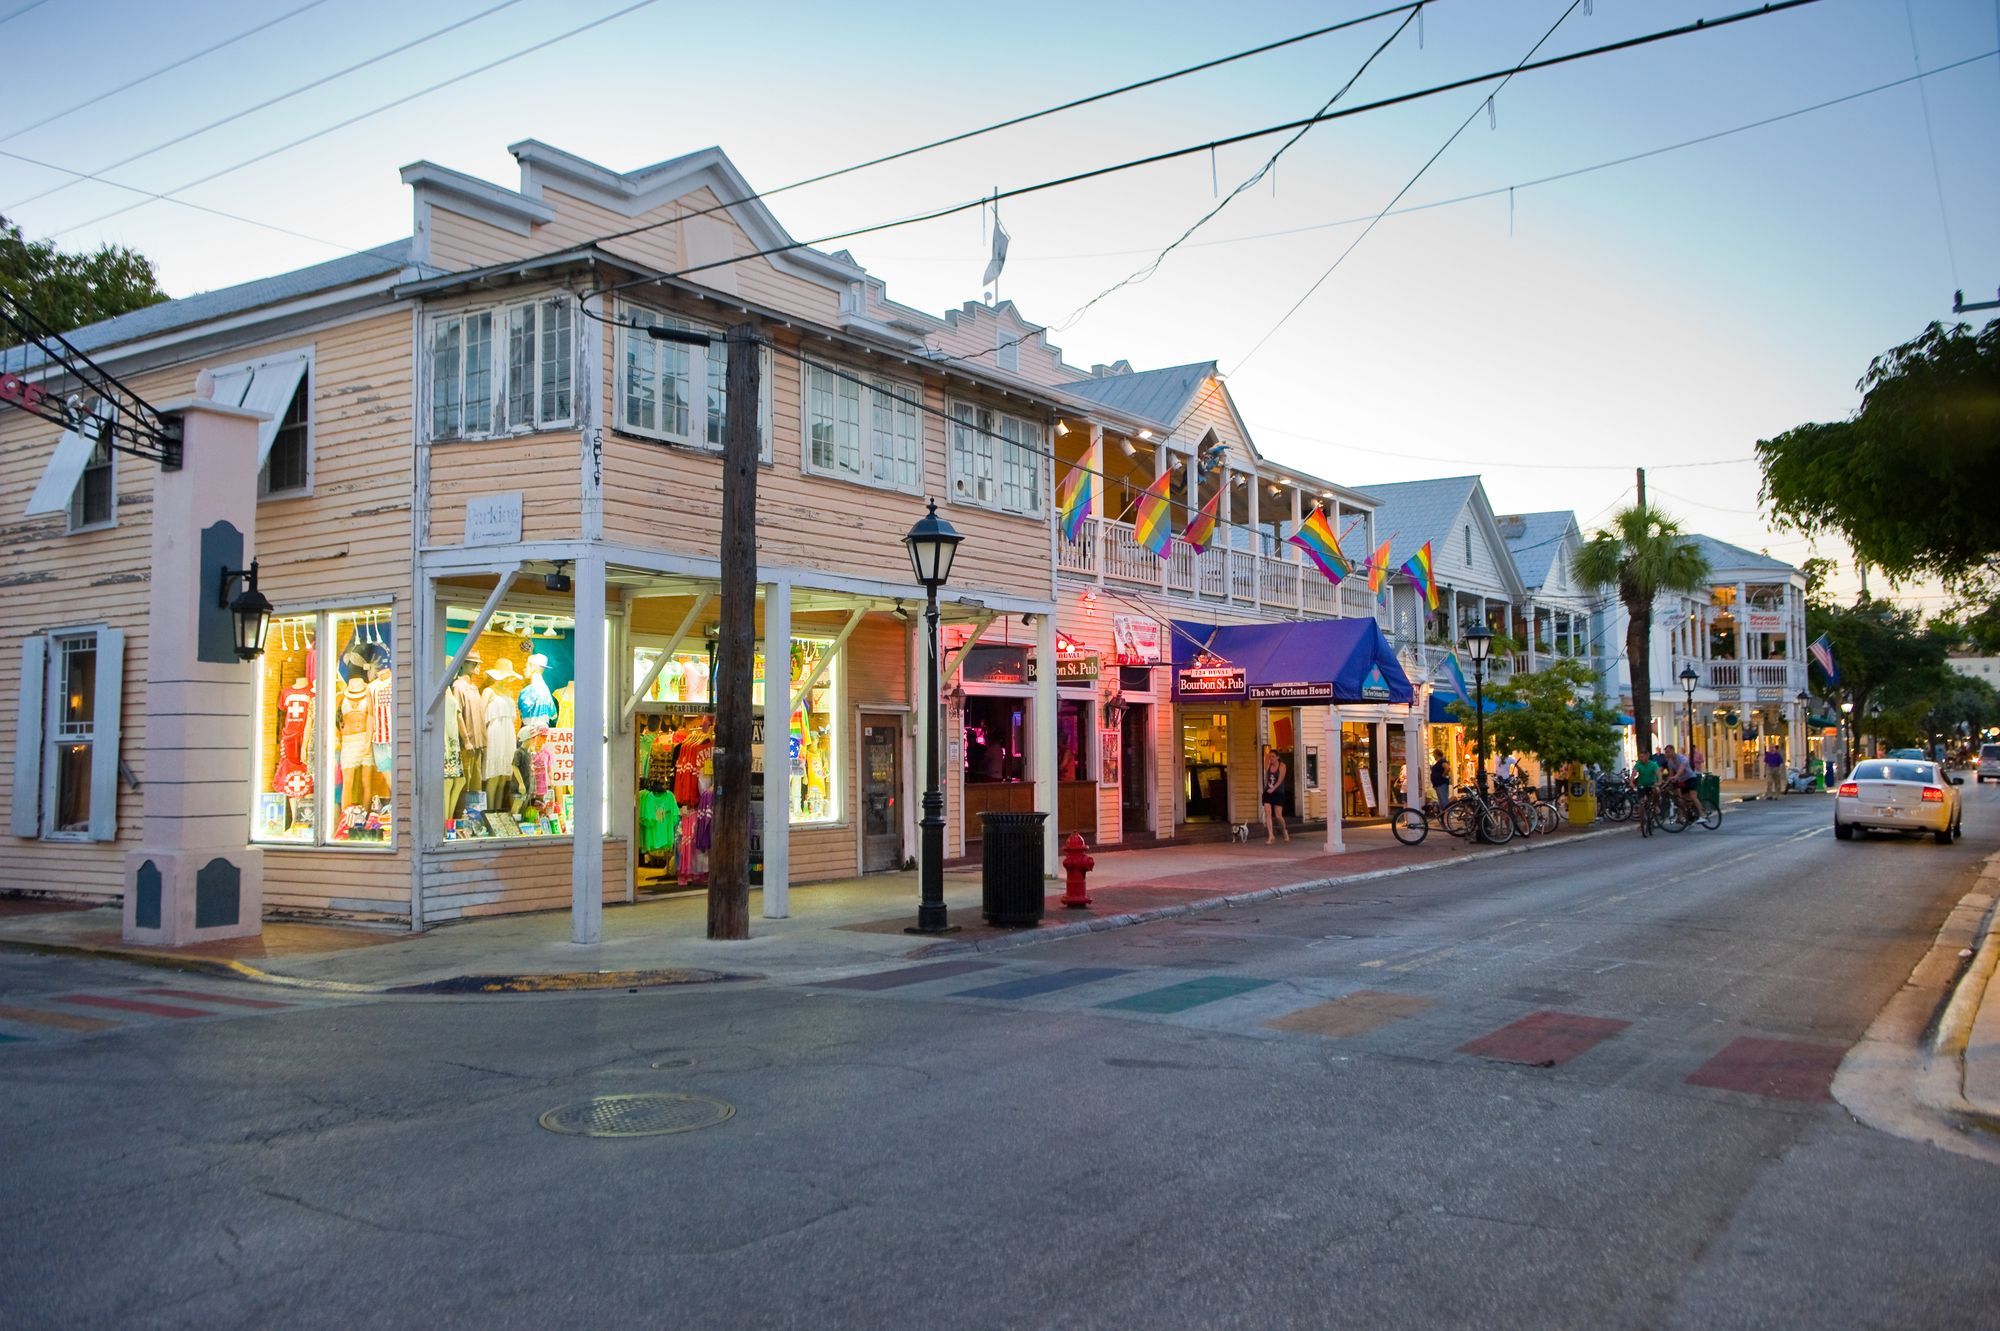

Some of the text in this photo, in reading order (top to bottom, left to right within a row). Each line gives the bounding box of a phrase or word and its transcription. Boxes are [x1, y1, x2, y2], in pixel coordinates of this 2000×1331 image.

[1067, 662, 1079, 676] St.
[1080, 661, 1098, 675] Pub
[1180, 677, 1244, 690] Bourbon St. Pub
[1251, 686, 1330, 697] The New Orleans House
[674, 704, 710, 713] CARIBBEA
